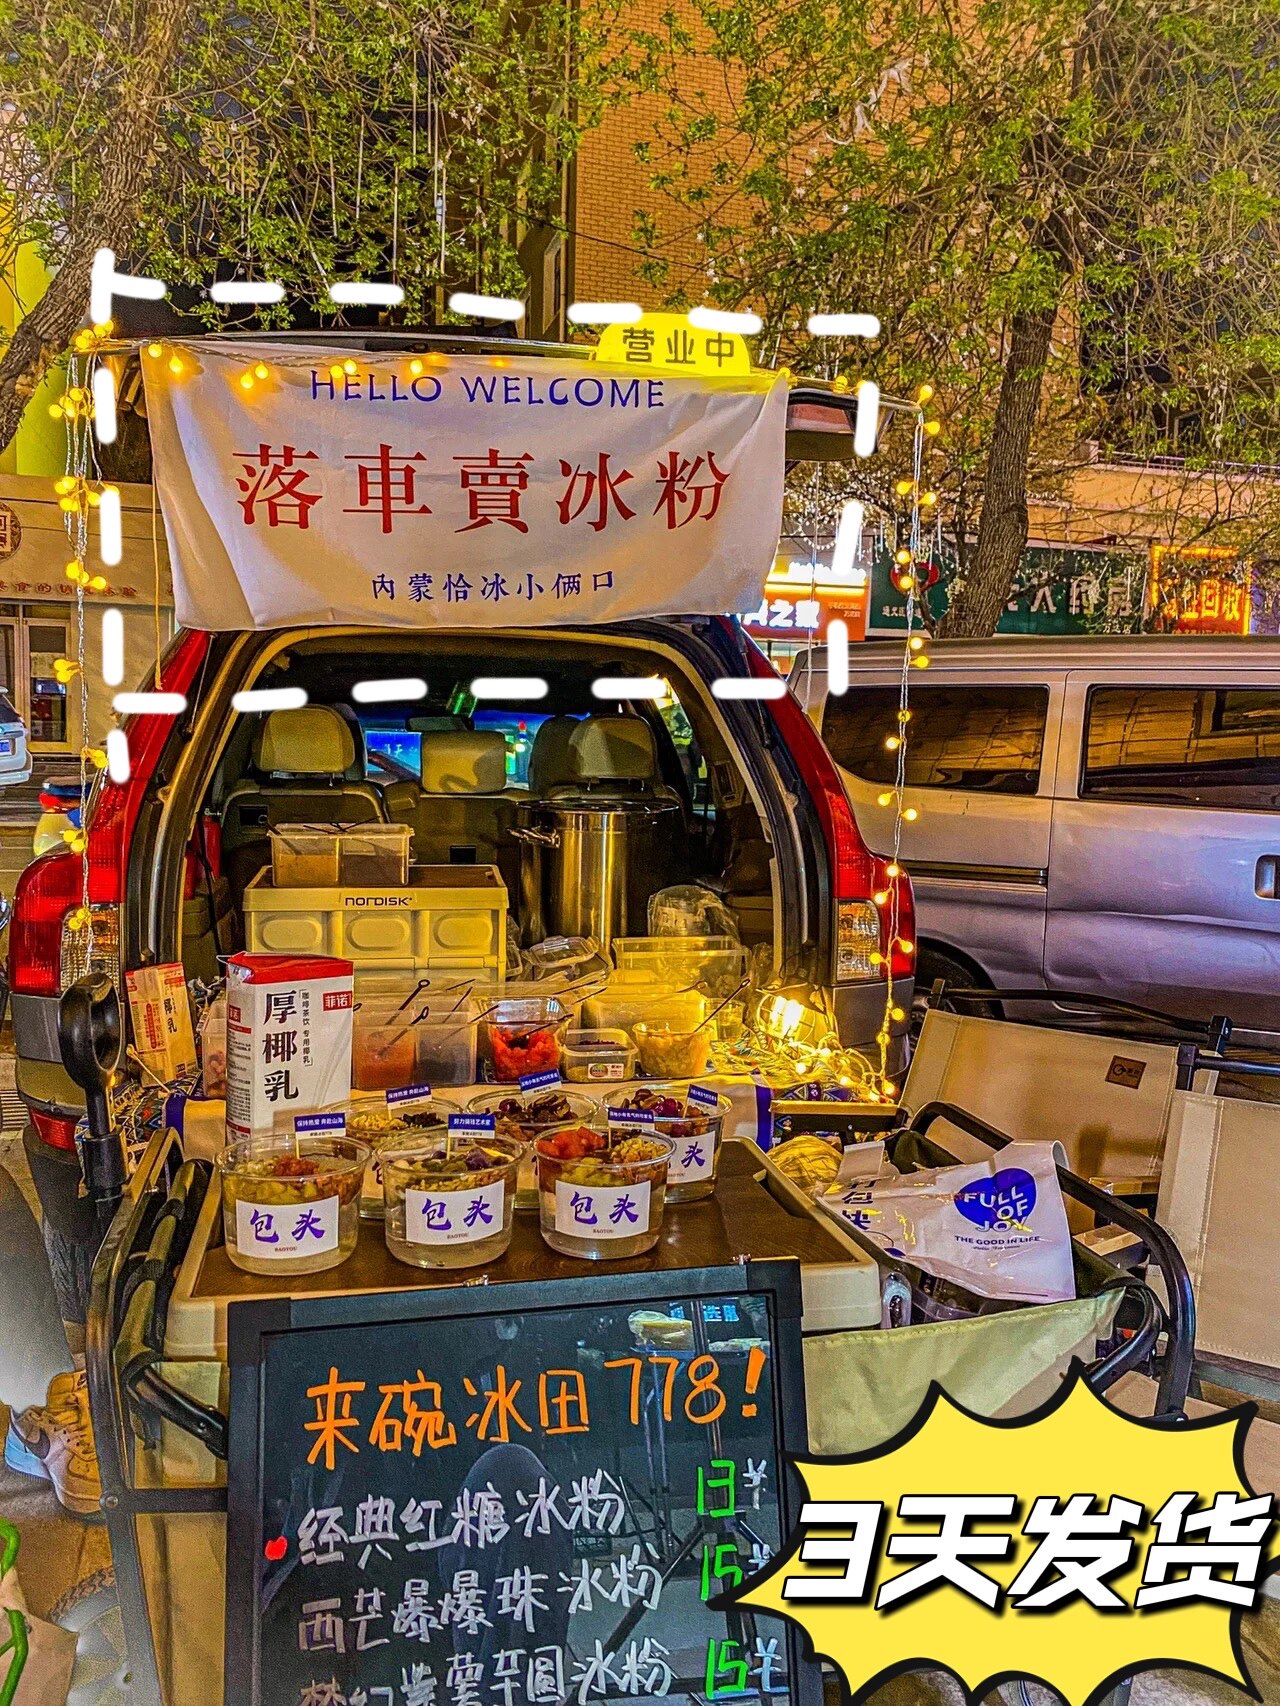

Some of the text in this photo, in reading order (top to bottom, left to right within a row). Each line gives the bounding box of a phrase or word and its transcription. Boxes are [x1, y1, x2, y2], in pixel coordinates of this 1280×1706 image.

[622, 328, 735, 367] 营业中
[310, 369, 665, 408] HELLO WELCOME
[232, 443, 731, 534] 落車賣冰粉
[325, 994, 350, 1008] 菲诺
[262, 990, 300, 1102] 厚椰乳
[422, 1195, 493, 1232] 包头
[570, 1191, 639, 1225] 包头
[963, 1186, 1024, 1208] FULL
[997, 1199, 1028, 1220] OF
[250, 1208, 326, 1243] 包头
[954, 1235, 974, 1244] THE
[976, 1238, 1005, 1246] GOOD
[1019, 1235, 1041, 1243] LIFE
[975, 1216, 1031, 1232] JOY
[298, 1468, 625, 1570] 经典红糖冰粉
